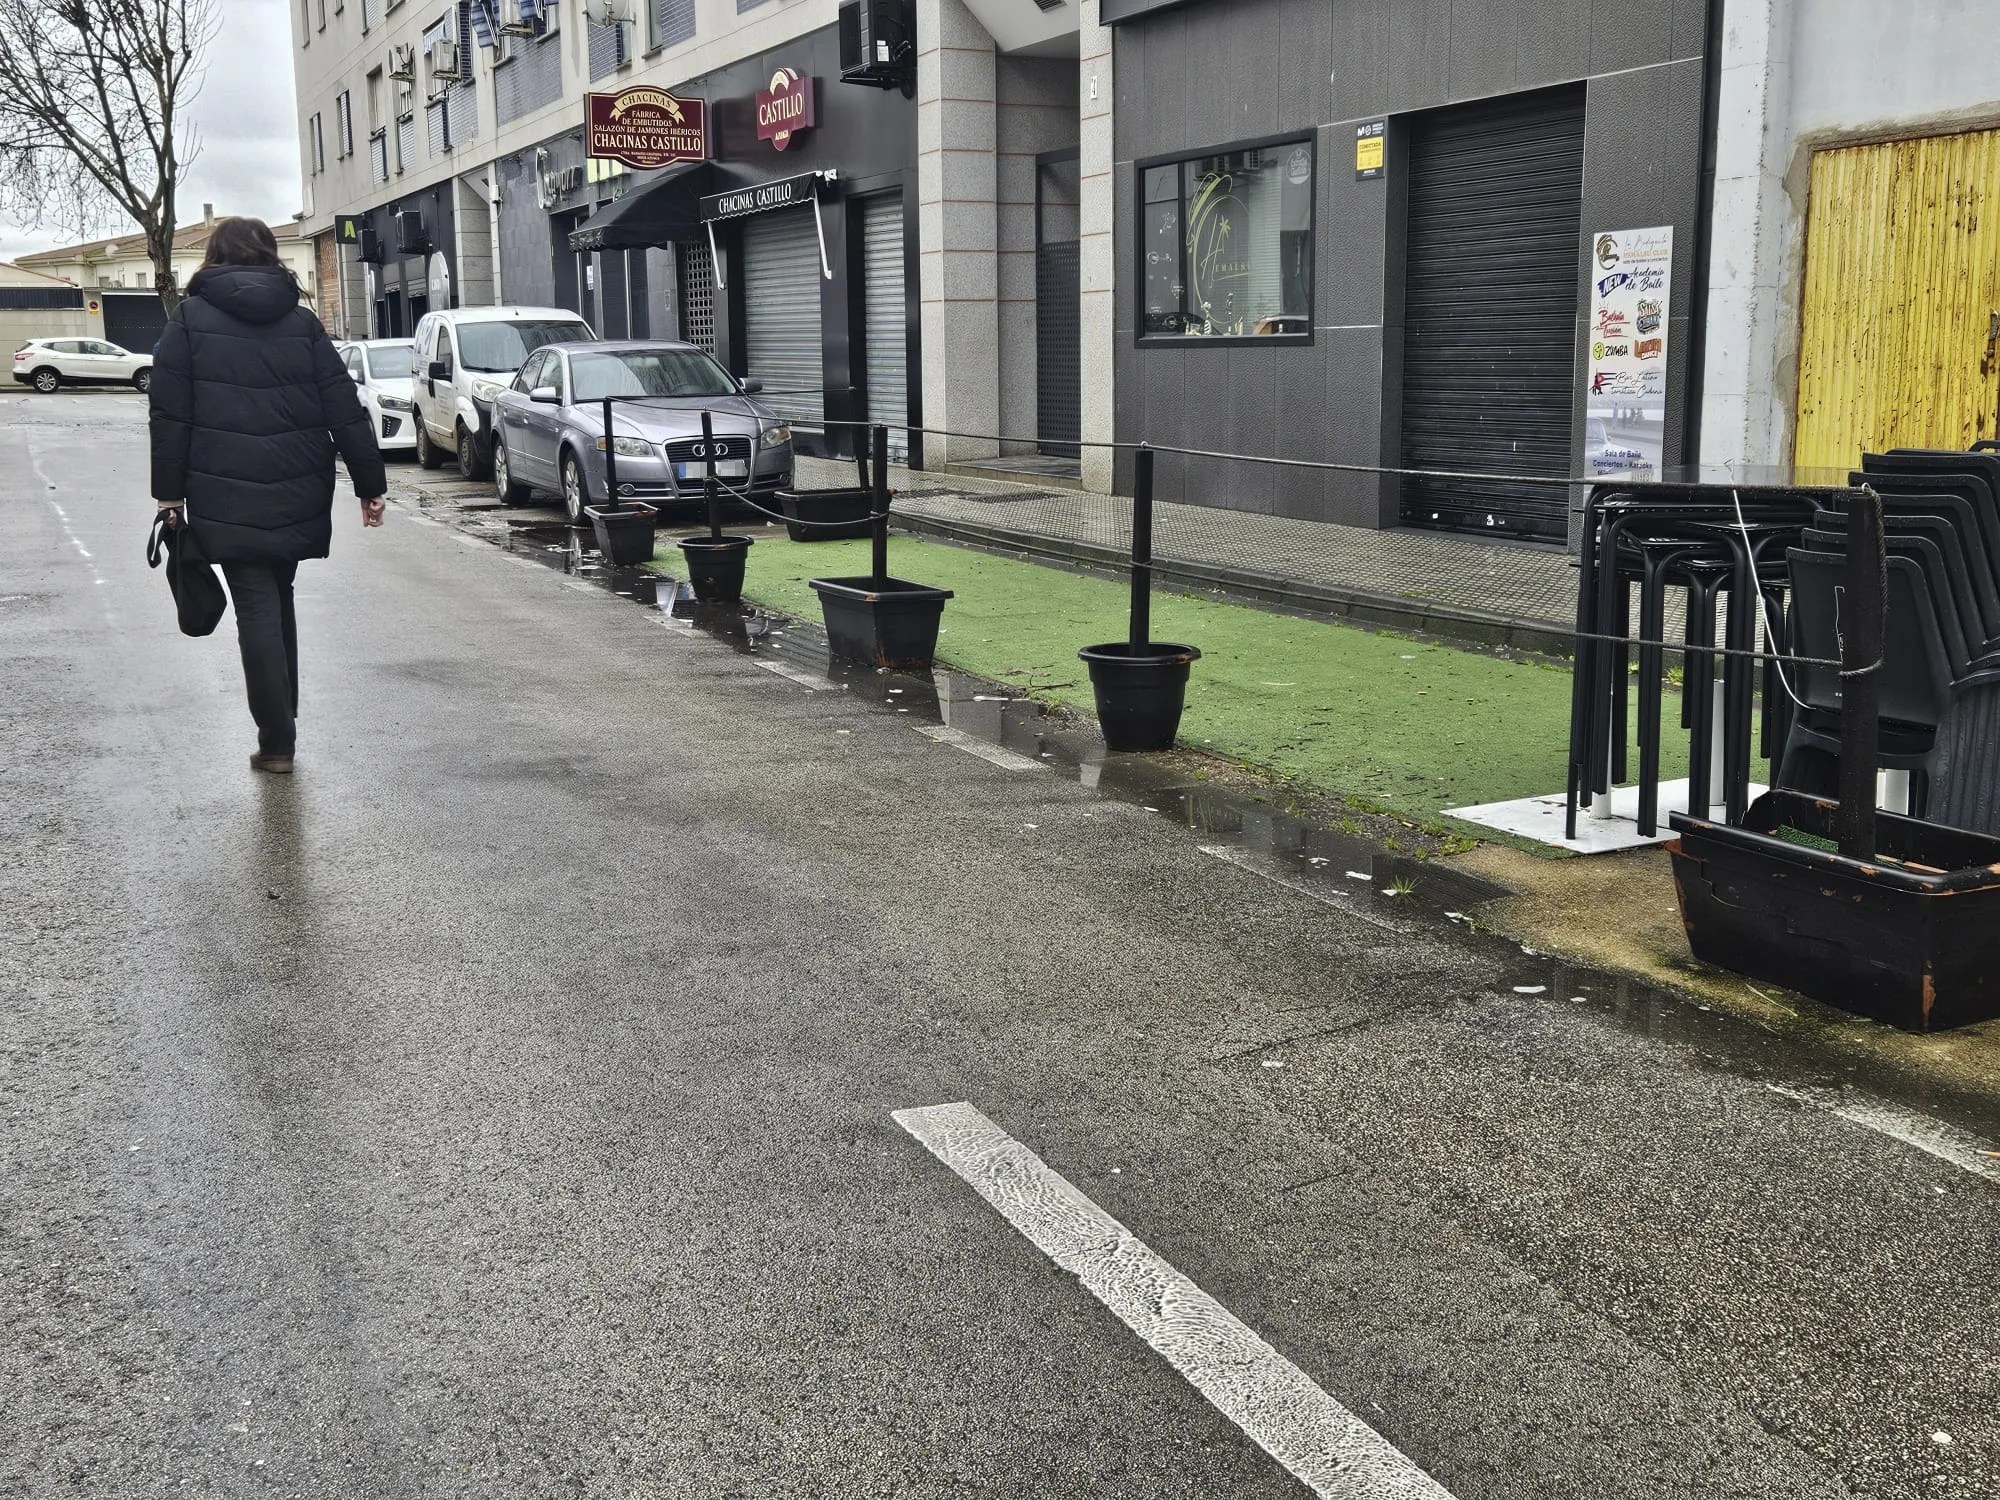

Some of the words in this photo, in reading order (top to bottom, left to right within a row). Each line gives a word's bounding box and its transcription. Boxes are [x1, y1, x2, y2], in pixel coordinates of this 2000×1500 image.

[622, 94, 671, 108] CHACINAS
[632, 110, 660, 119] FÁBRICA
[760, 93, 803, 126] CASTILLO
[633, 118, 673, 127] EMBUTIDOS
[594, 124, 625, 133] SALAZÓN
[638, 126, 668, 135] JAMONES
[671, 127, 701, 136] IBÉRICOS
[594, 133, 648, 149] CHACINAS
[651, 136, 701, 151] CASTILLO
[719, 192, 754, 214] CHACINAS
[756, 183, 792, 206] CASTILLO
[1628, 266, 1665, 279] Academia
[1602, 273, 1623, 294] NEW
[1625, 280, 1637, 291] de
[1640, 277, 1664, 292] Baile
[1605, 344, 1629, 357] ZUMBA
[1605, 449, 1617, 458] Sala
[1619, 450, 1626, 458] de
[1592, 460, 1623, 468] Conciertos
